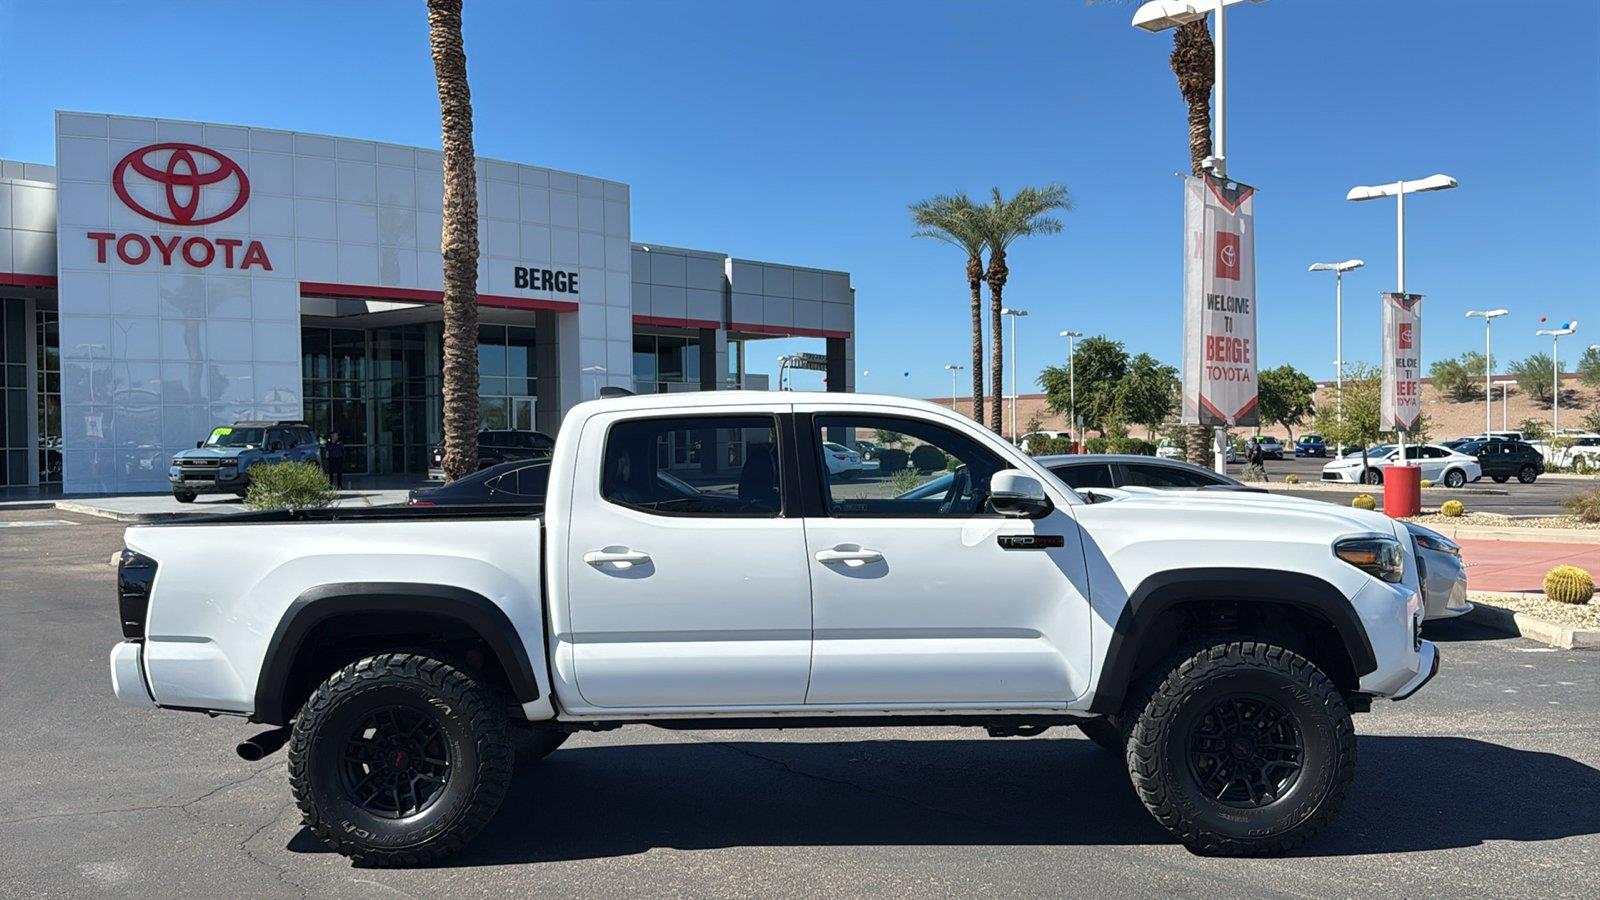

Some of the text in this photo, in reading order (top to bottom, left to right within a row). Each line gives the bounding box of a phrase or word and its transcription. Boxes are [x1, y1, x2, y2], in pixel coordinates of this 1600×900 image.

[87, 232, 273, 271] TOYOTA
[514, 266, 579, 294] BERGE
[1207, 336, 1250, 363] BERGE
[1206, 365, 1250, 382] TOYOTA
[999, 536, 1035, 547] TRD
